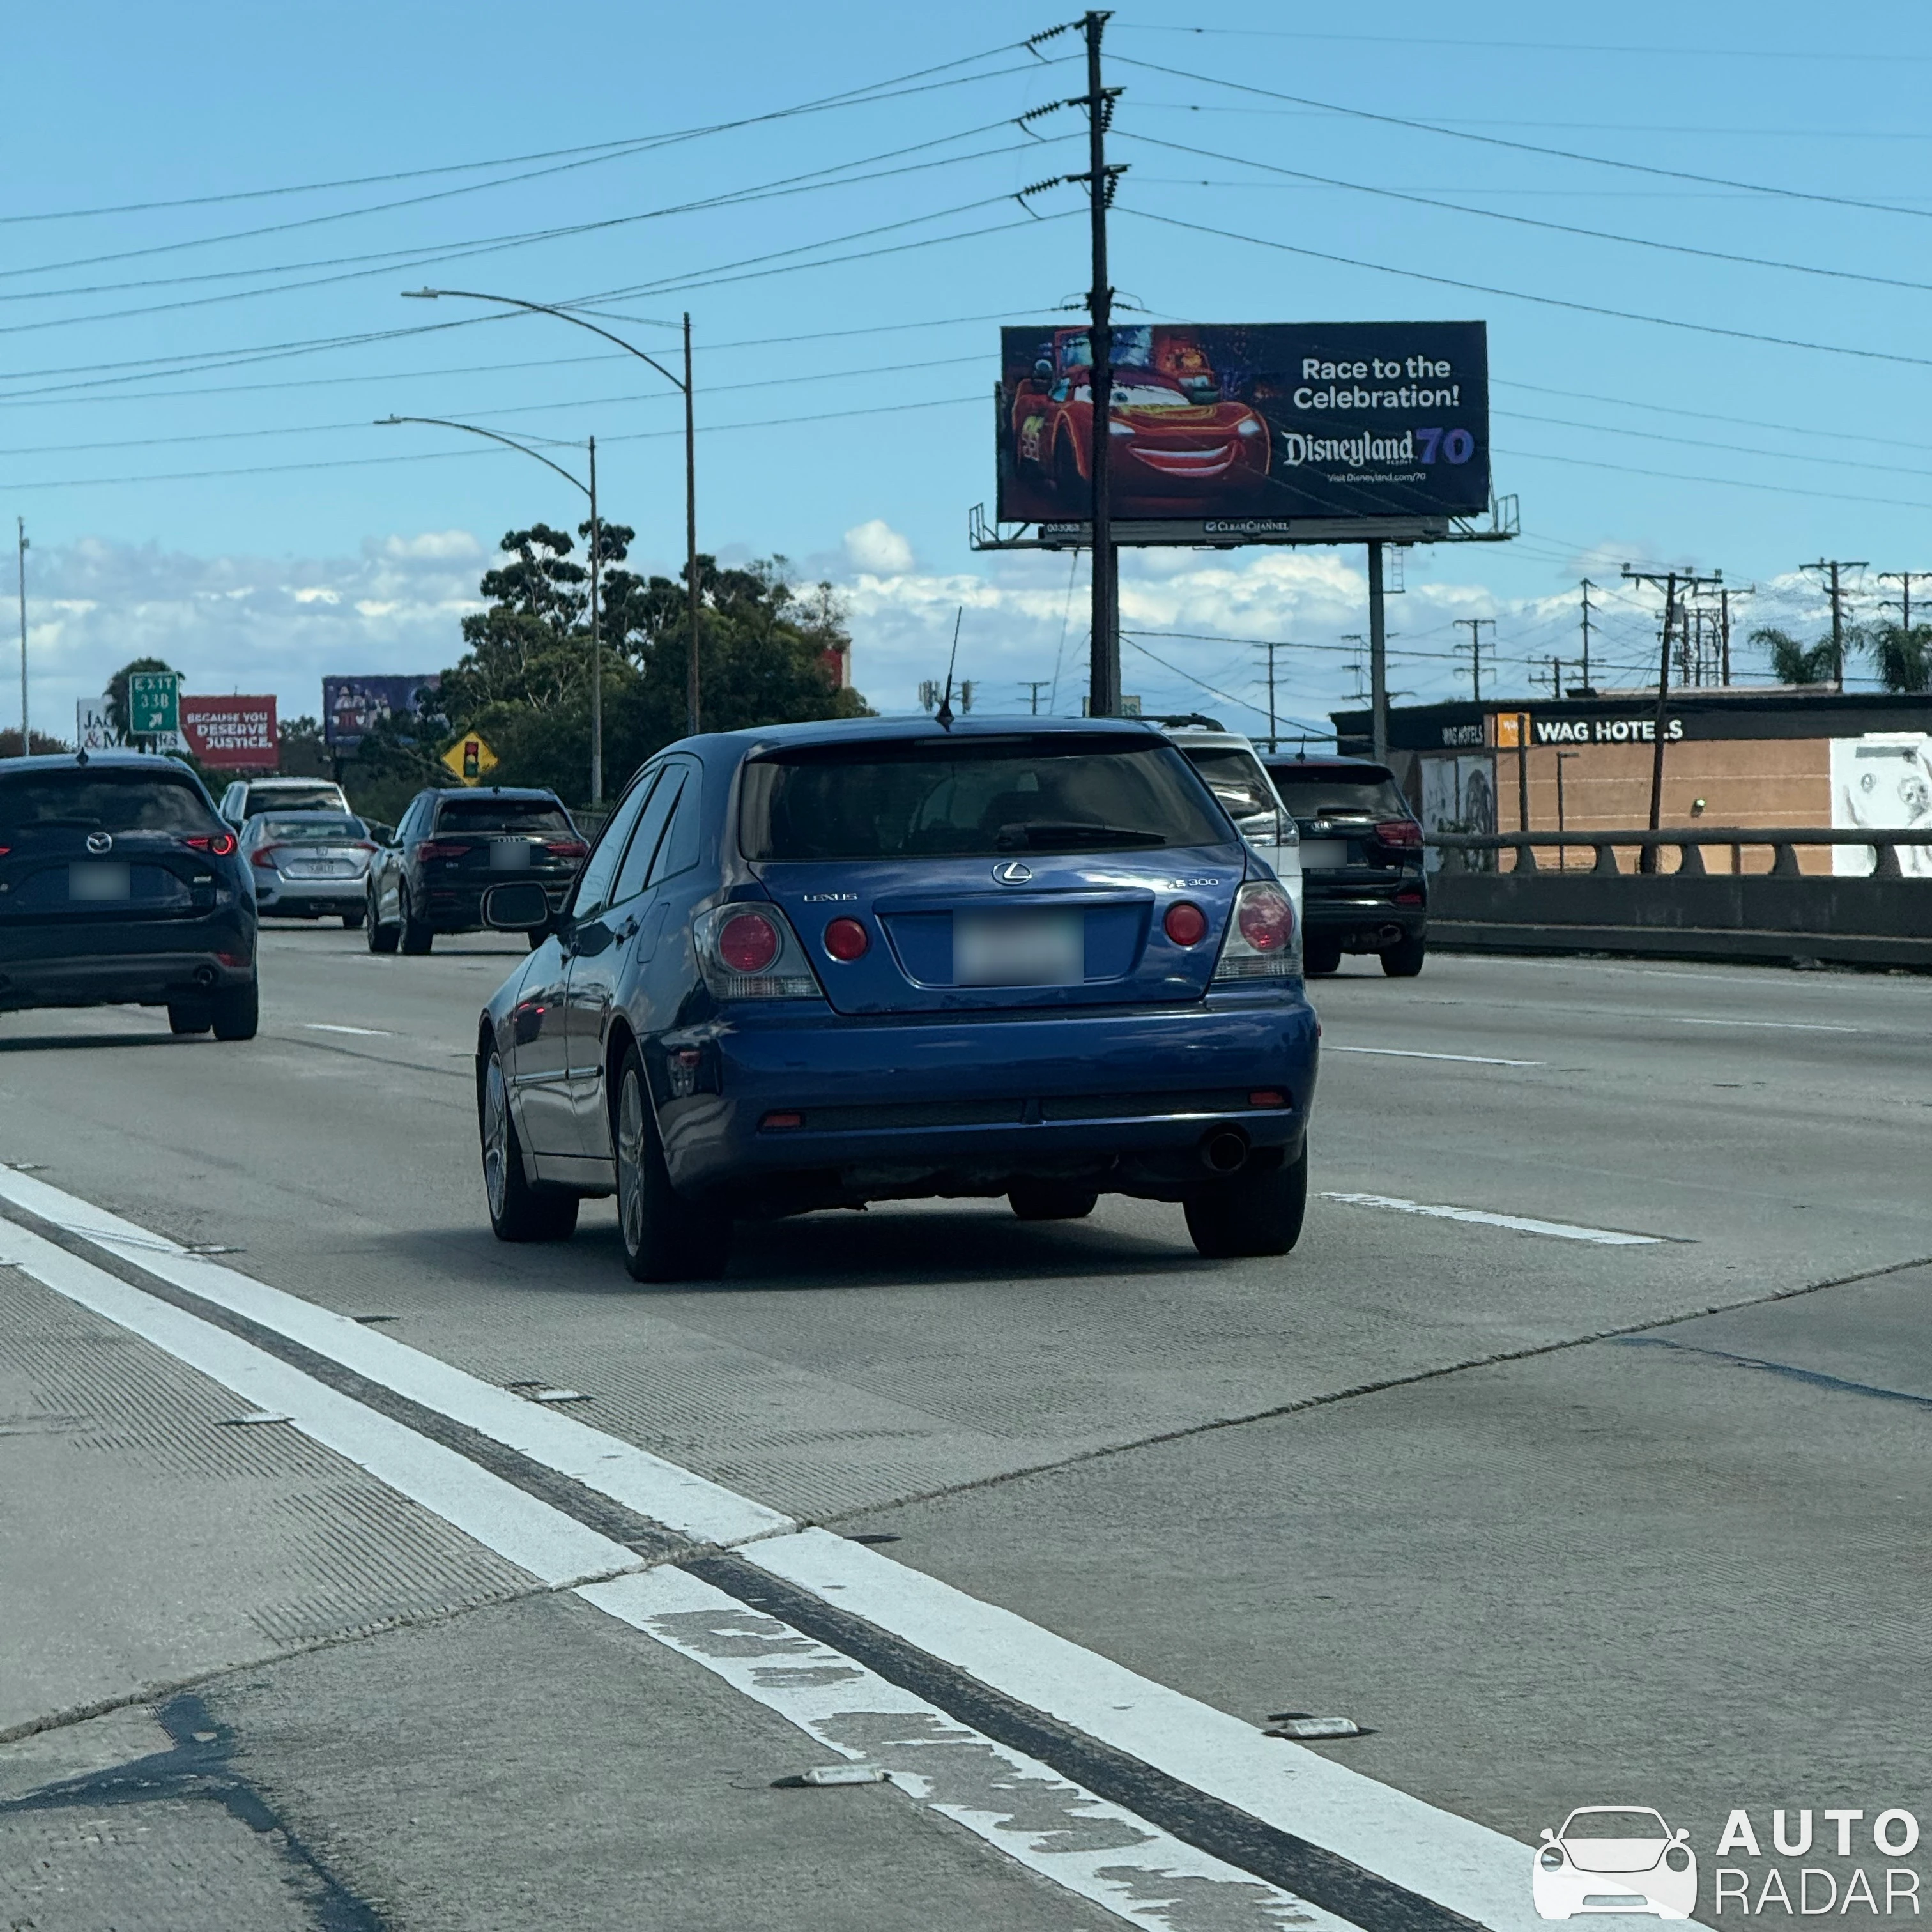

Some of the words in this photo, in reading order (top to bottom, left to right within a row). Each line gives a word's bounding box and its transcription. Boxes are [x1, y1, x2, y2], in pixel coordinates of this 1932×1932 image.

[1302, 358, 1368, 380] Race
[1372, 358, 1401, 379] to
[1406, 355, 1451, 378] the
[1292, 384, 1460, 410] Celebration!
[1280, 429, 1414, 468] Disneyland
[1415, 427, 1475, 465] 70
[134, 677, 173, 691] EXIT
[187, 712, 240, 724] BECAUSE
[243, 712, 268, 722] YOU
[196, 723, 268, 737] DESERVE
[1537, 721, 1589, 742] WAG
[1596, 720, 1683, 740] HOTES
[84, 730, 101, 751] &
[205, 735, 273, 751] JUSTICE.
[1187, 878, 1219, 887] 300
[803, 893, 858, 902] LEXUS
